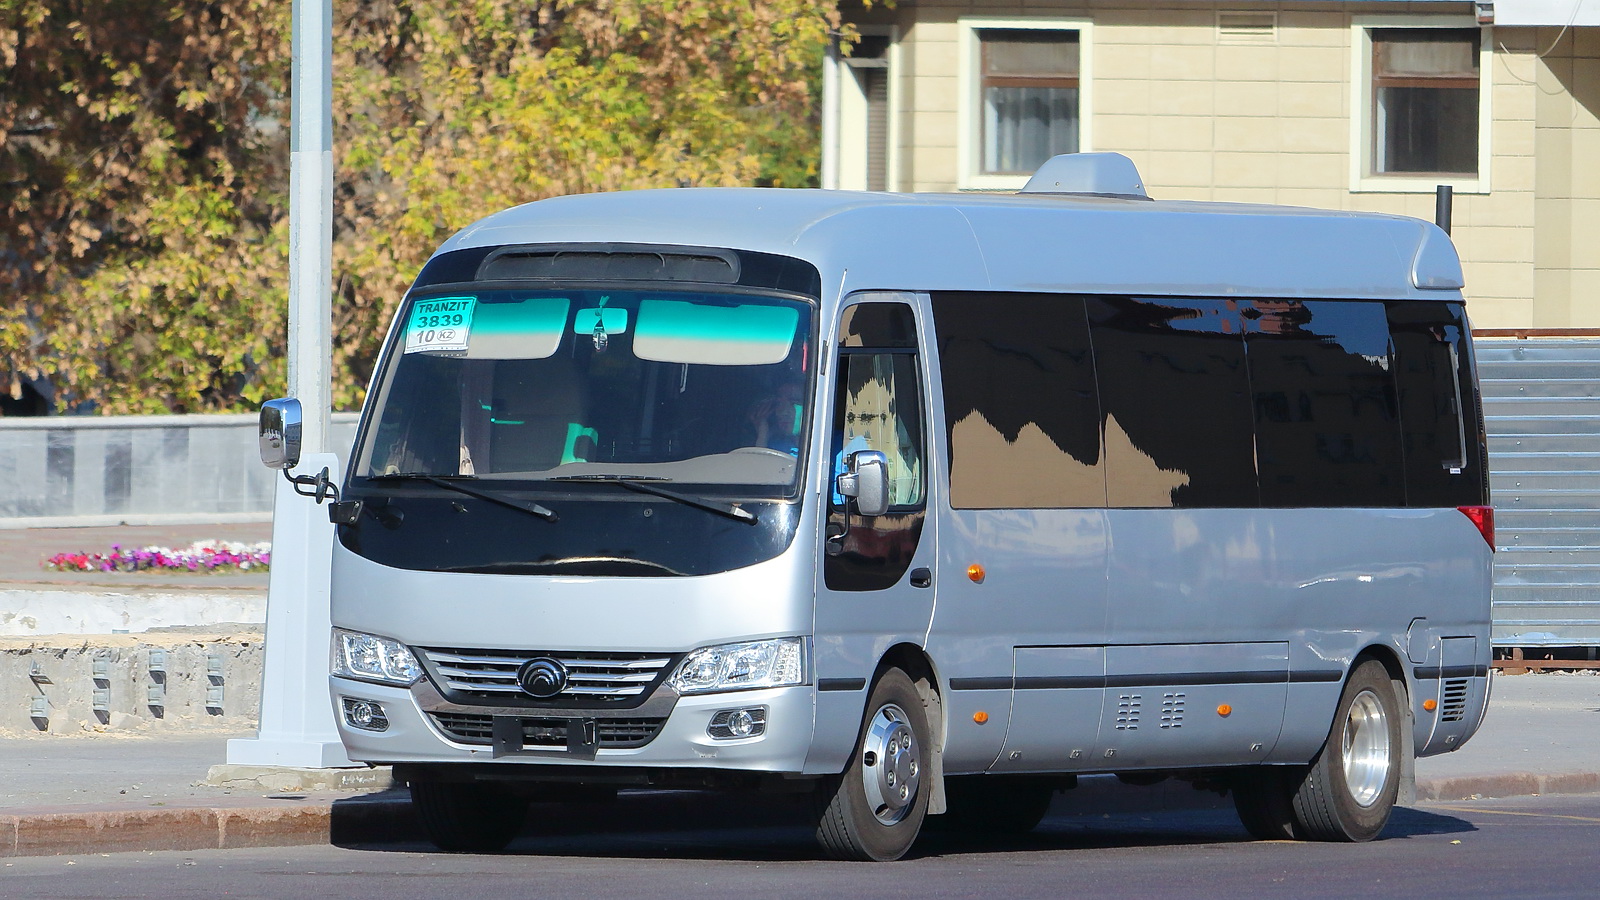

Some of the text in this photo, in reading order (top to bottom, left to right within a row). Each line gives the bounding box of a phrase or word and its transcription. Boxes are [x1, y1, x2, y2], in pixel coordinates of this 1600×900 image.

[419, 301, 469, 313] TRANZIT
[417, 314, 463, 328] 3839
[416, 329, 453, 343] 10 KZ
